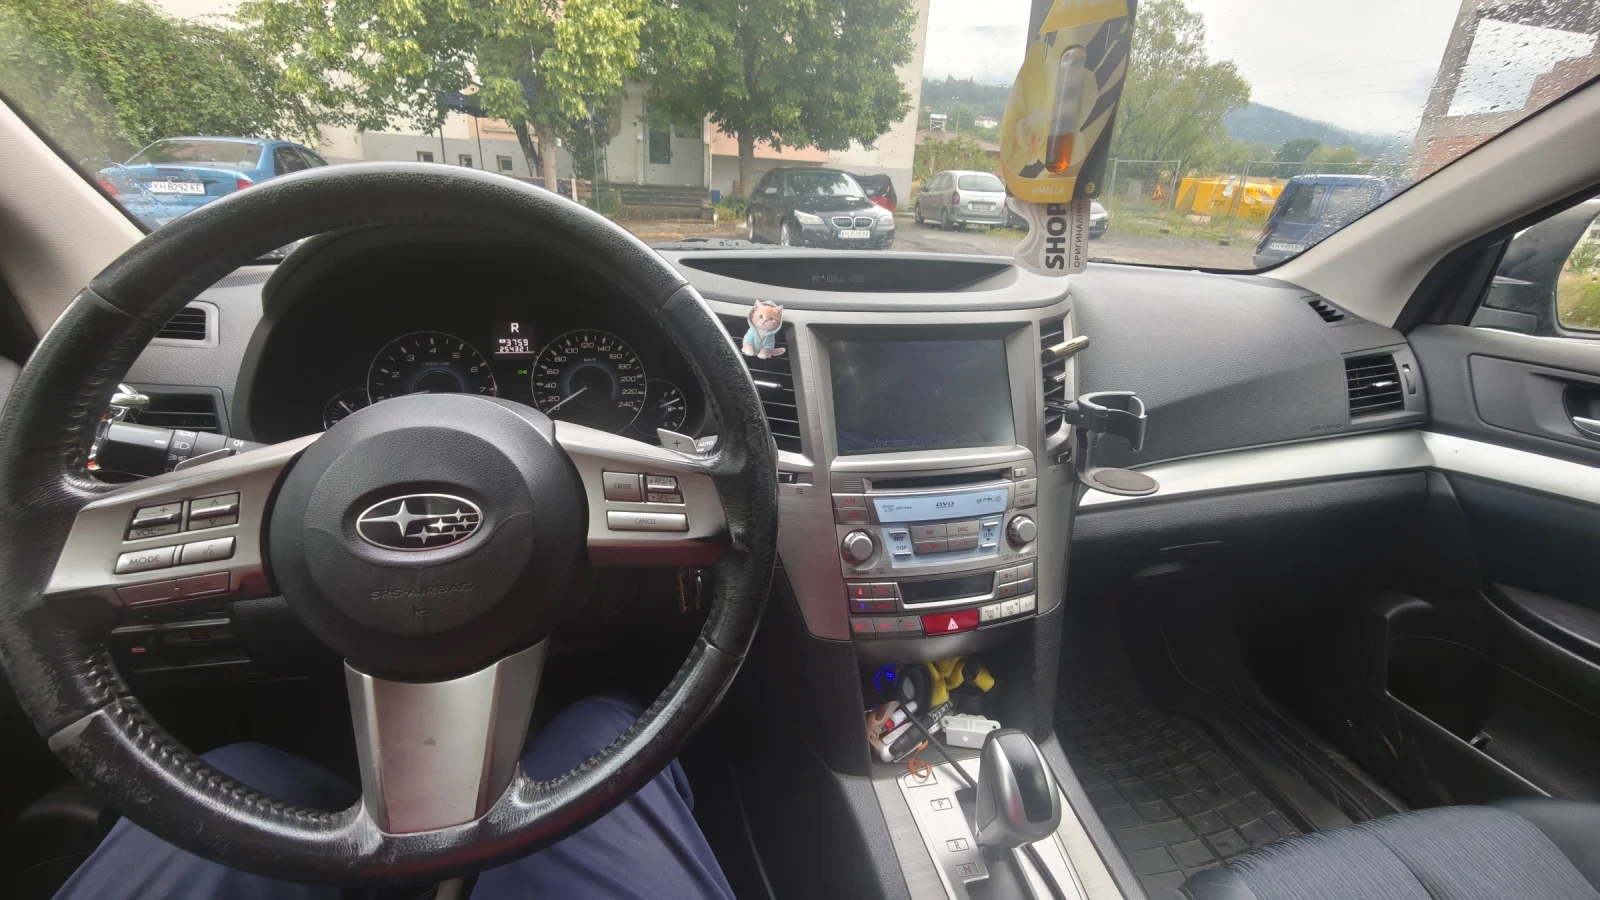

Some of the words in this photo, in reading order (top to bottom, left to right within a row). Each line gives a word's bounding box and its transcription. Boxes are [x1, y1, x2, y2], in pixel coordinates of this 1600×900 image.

[1031, 185, 1065, 195] VANILLA
[1045, 203, 1068, 270] SHOP
[1074, 203, 1084, 268] ОРИГИНАЛНИ
[510, 322, 520, 333] R
[634, 517, 658, 525] CANCEL
[135, 528, 156, 537] VOL
[128, 555, 162, 567] MODE
[938, 800, 944, 808] P
[954, 841, 962, 850] R
[963, 865, 973, 875] N
